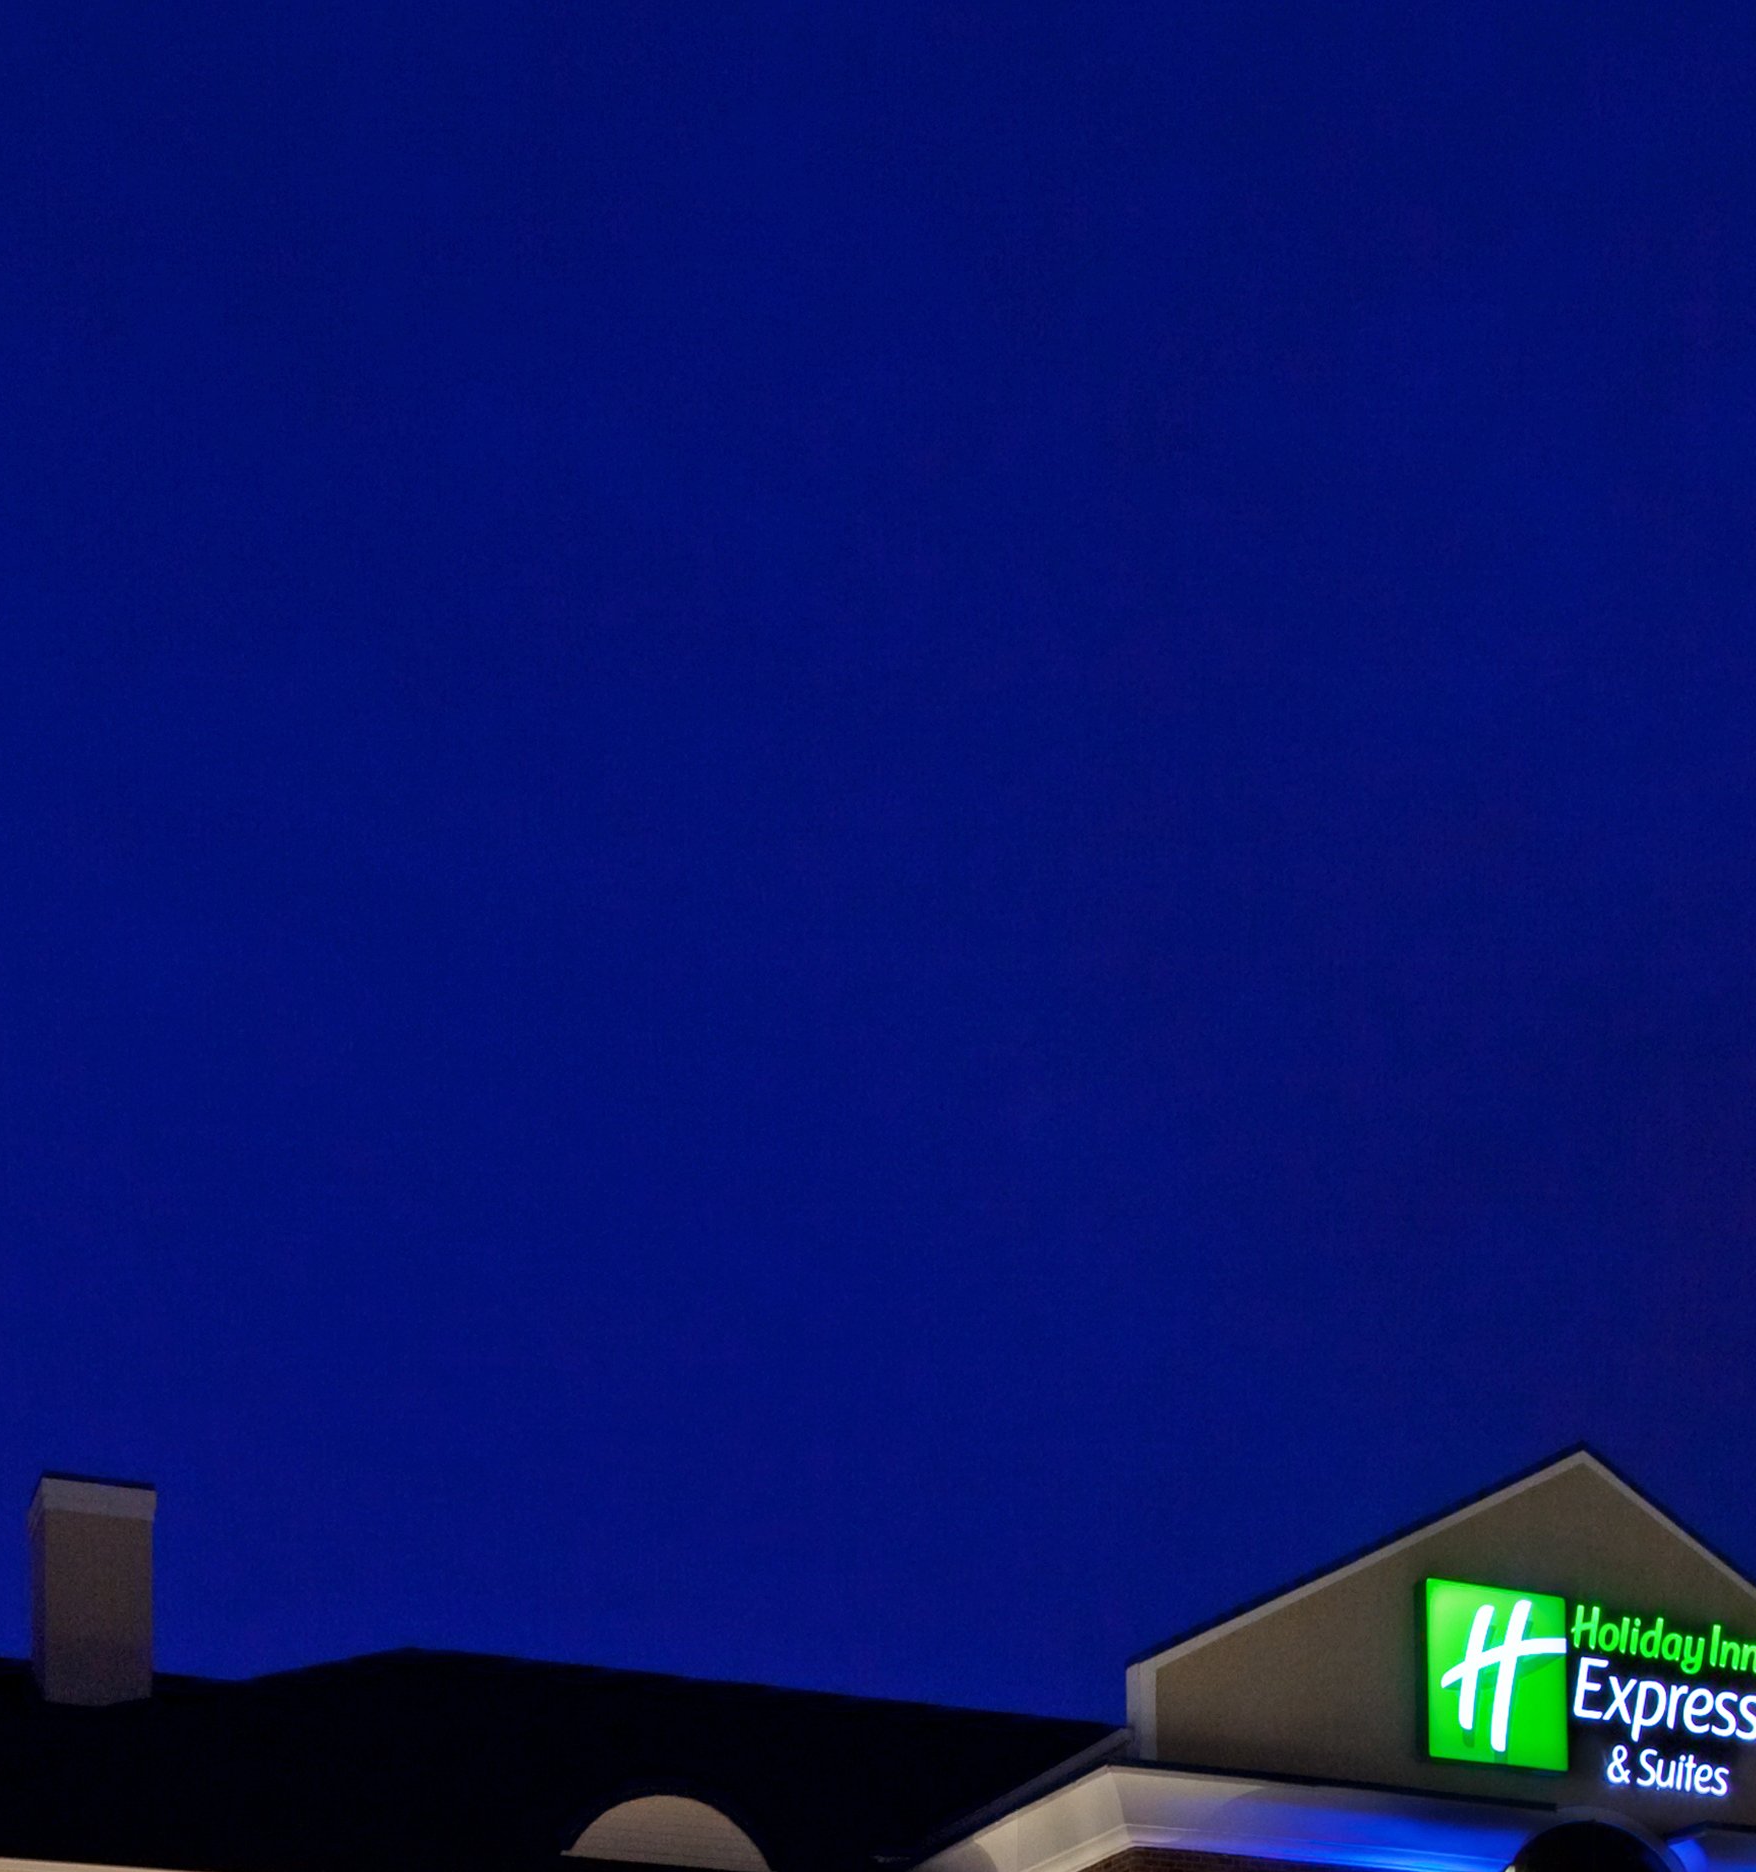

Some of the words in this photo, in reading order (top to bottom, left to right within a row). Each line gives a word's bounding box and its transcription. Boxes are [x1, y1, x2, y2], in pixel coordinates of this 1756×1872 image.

[1571, 1604, 1705, 1675] Holiday
[1606, 1744, 1631, 1785] &
[1636, 1748, 1730, 1797] Suites
